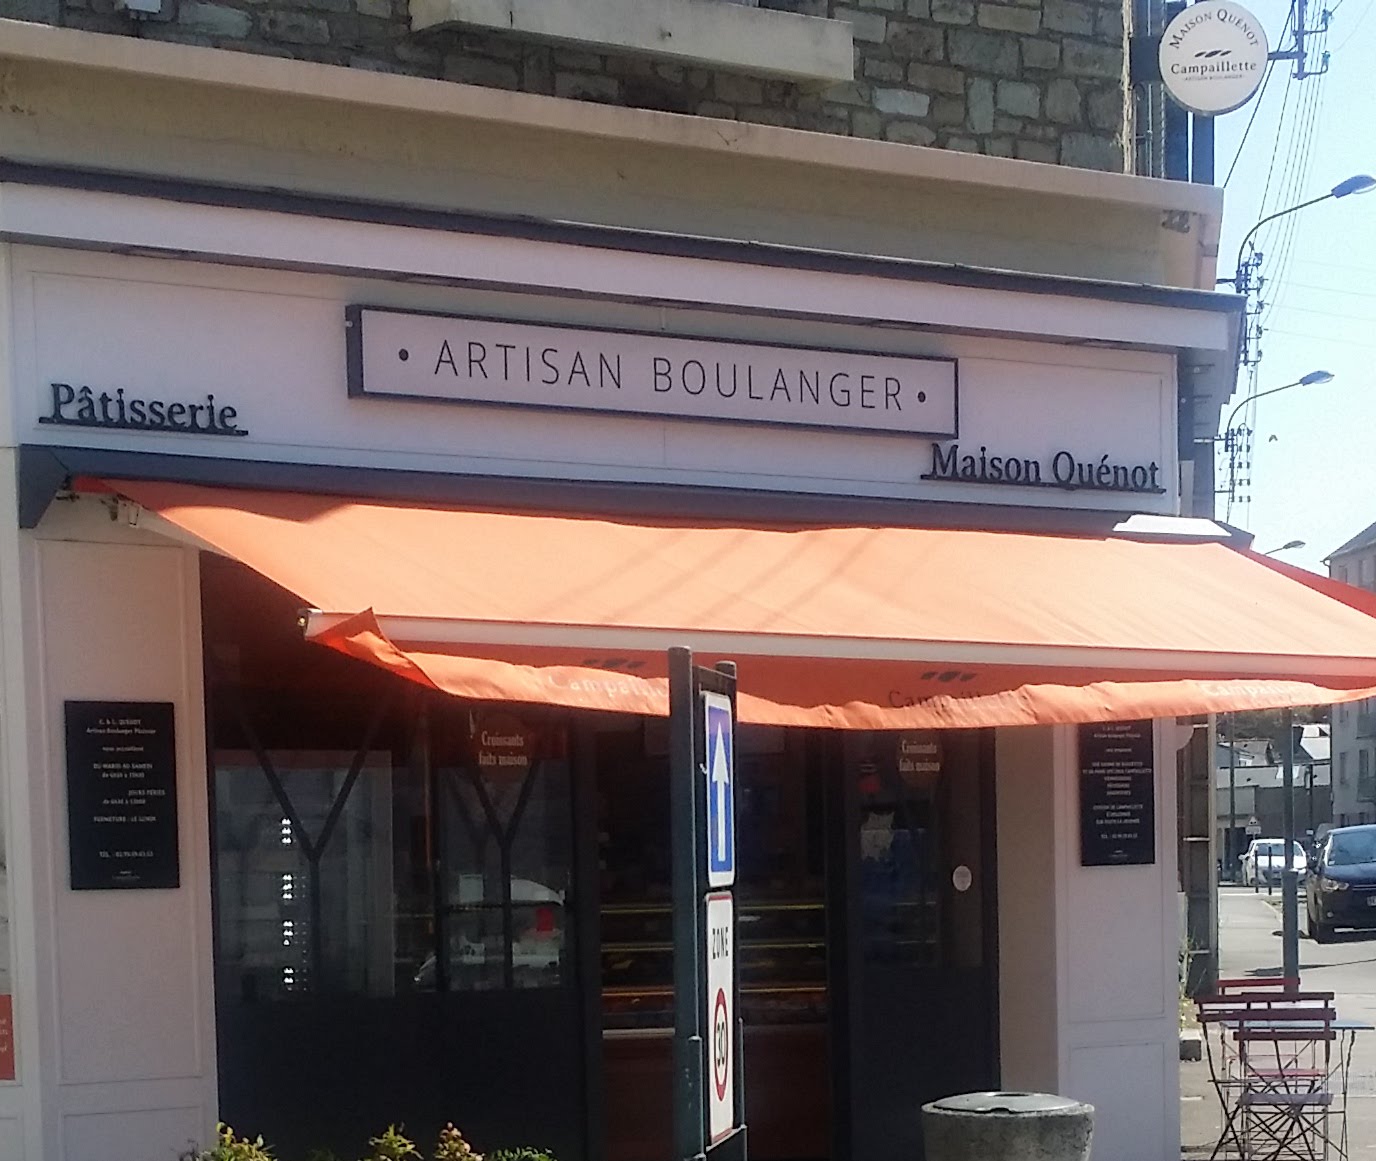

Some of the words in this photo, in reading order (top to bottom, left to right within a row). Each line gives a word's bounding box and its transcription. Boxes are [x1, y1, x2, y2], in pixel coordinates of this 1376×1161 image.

[1170, 12, 1212, 49] MAISON
[1171, 61, 1257, 75] Campaillette
[434, 338, 624, 390] ARTISAN
[652, 356, 904, 411] BOULANGER
[50, 382, 238, 431] Pâtisserie
[930, 442, 1042, 483] Maison
[1052, 450, 1160, 490] Quénot
[481, 730, 524, 746] Croissants
[479, 750, 497, 766] faits
[498, 752, 528, 766] maison
[712, 926, 729, 960] ZONE
[716, 1021, 725, 1068] 30
